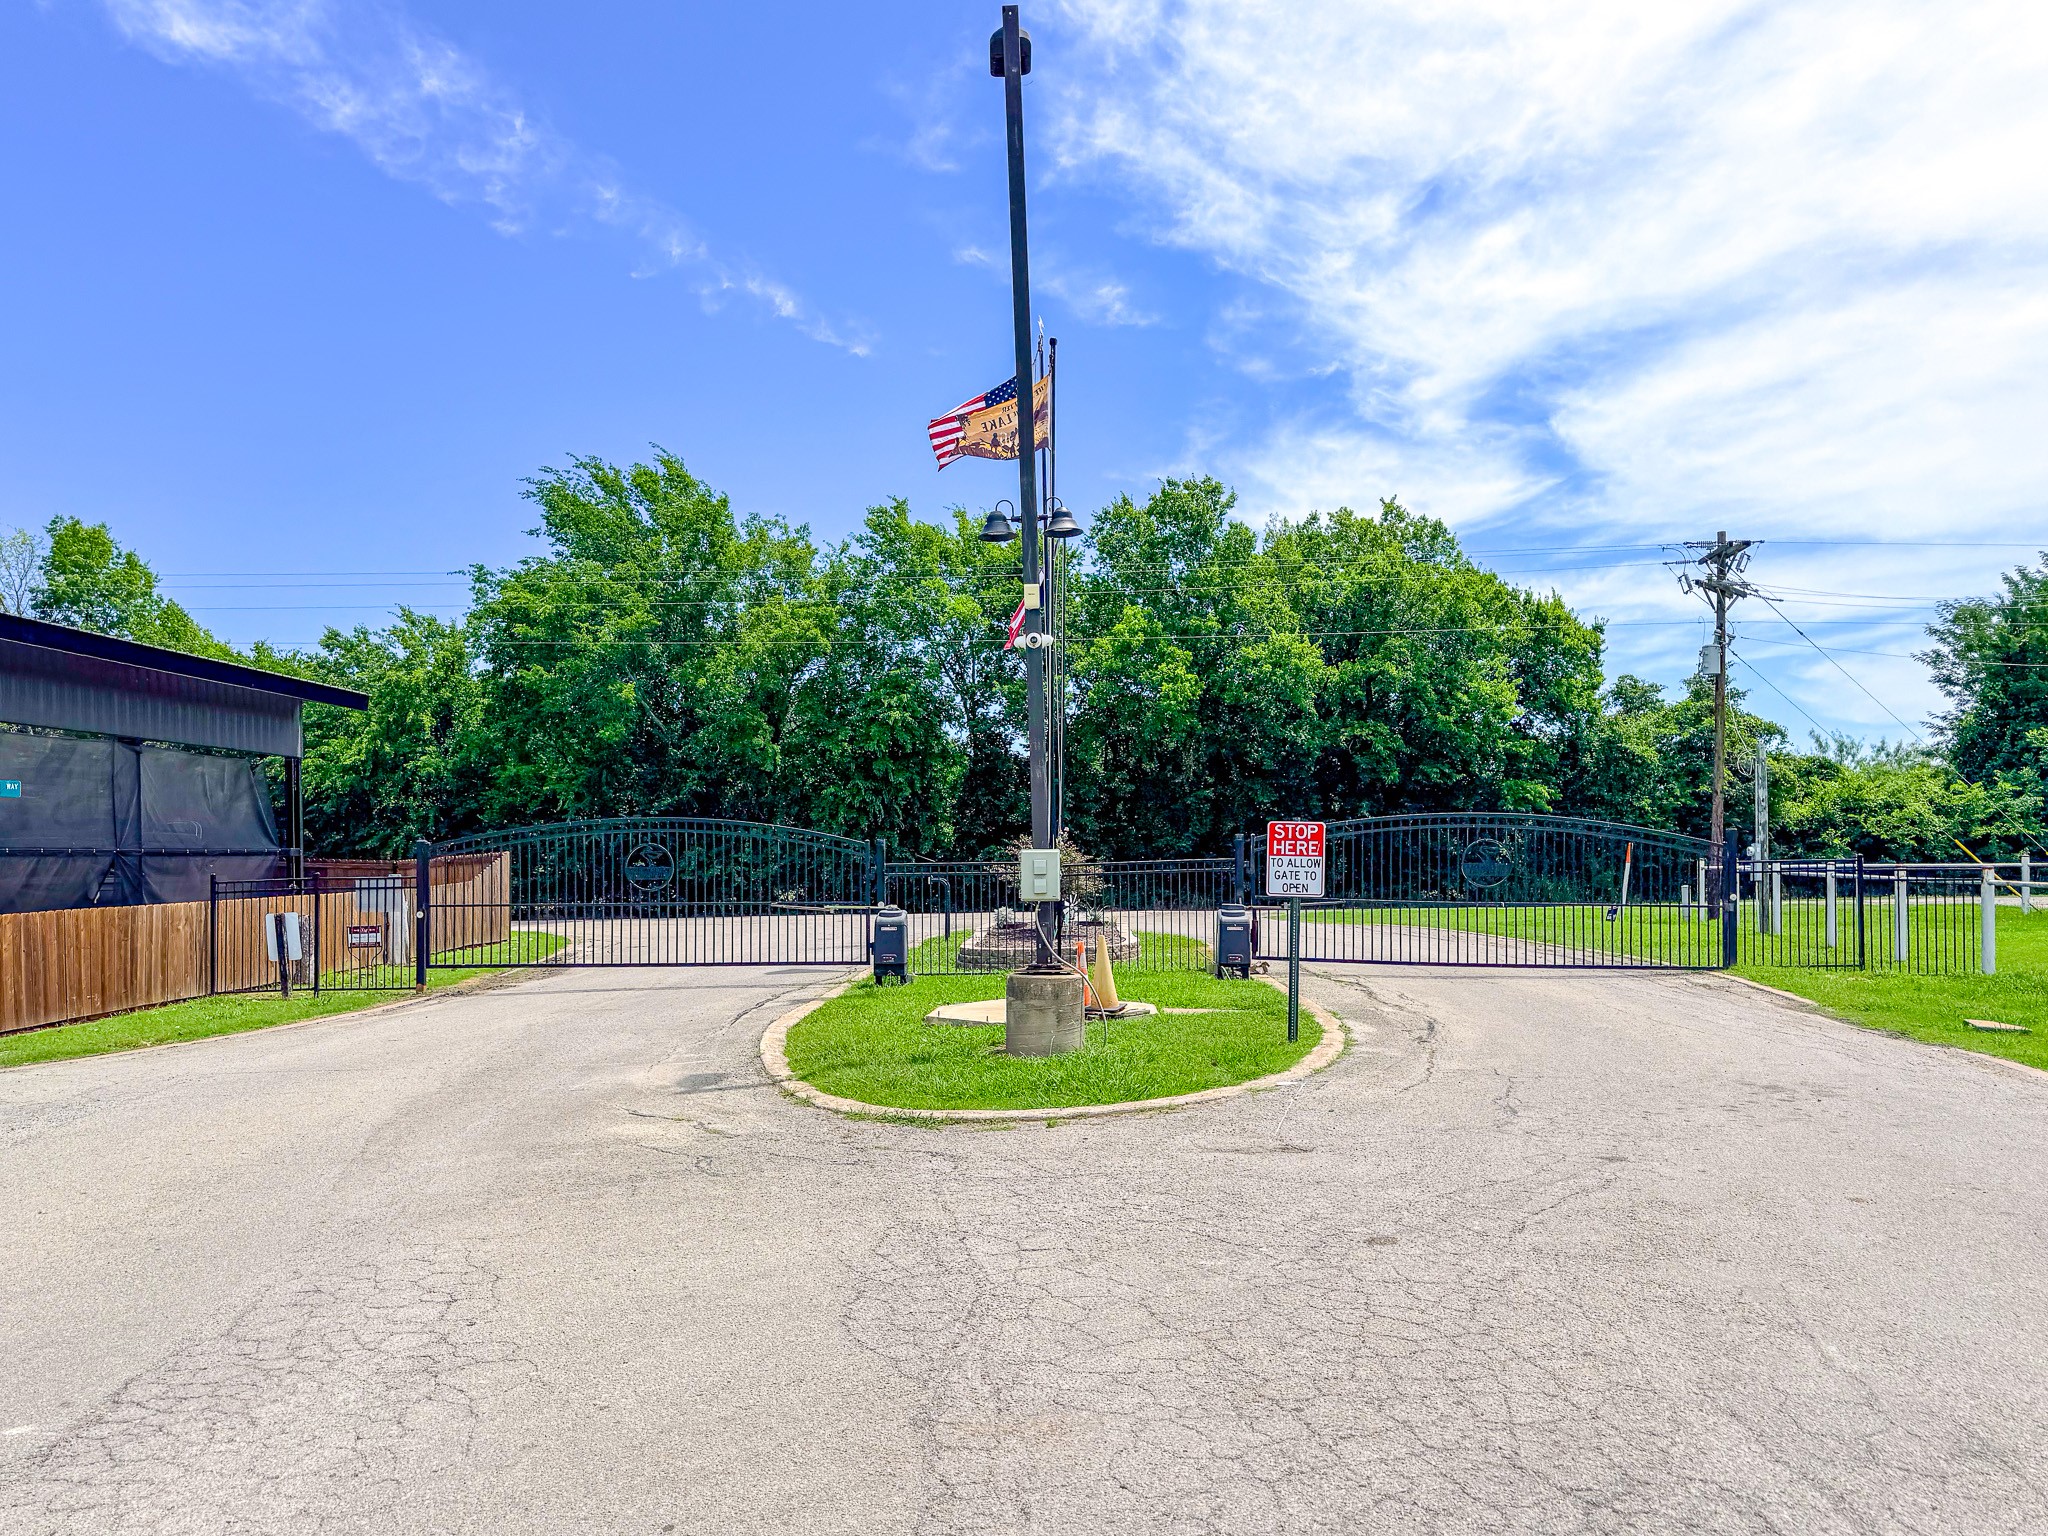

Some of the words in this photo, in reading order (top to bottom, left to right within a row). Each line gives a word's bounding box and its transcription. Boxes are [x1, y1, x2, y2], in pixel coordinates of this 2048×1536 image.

[1274, 824, 1319, 839] STOP
[1273, 840, 1319, 855] HERE
[1271, 857, 1284, 868] TO
[1286, 858, 1321, 868] ALLOW
[1274, 870, 1301, 880] GATE
[1304, 871, 1317, 881] TO
[1282, 882, 1309, 893] OPEN
